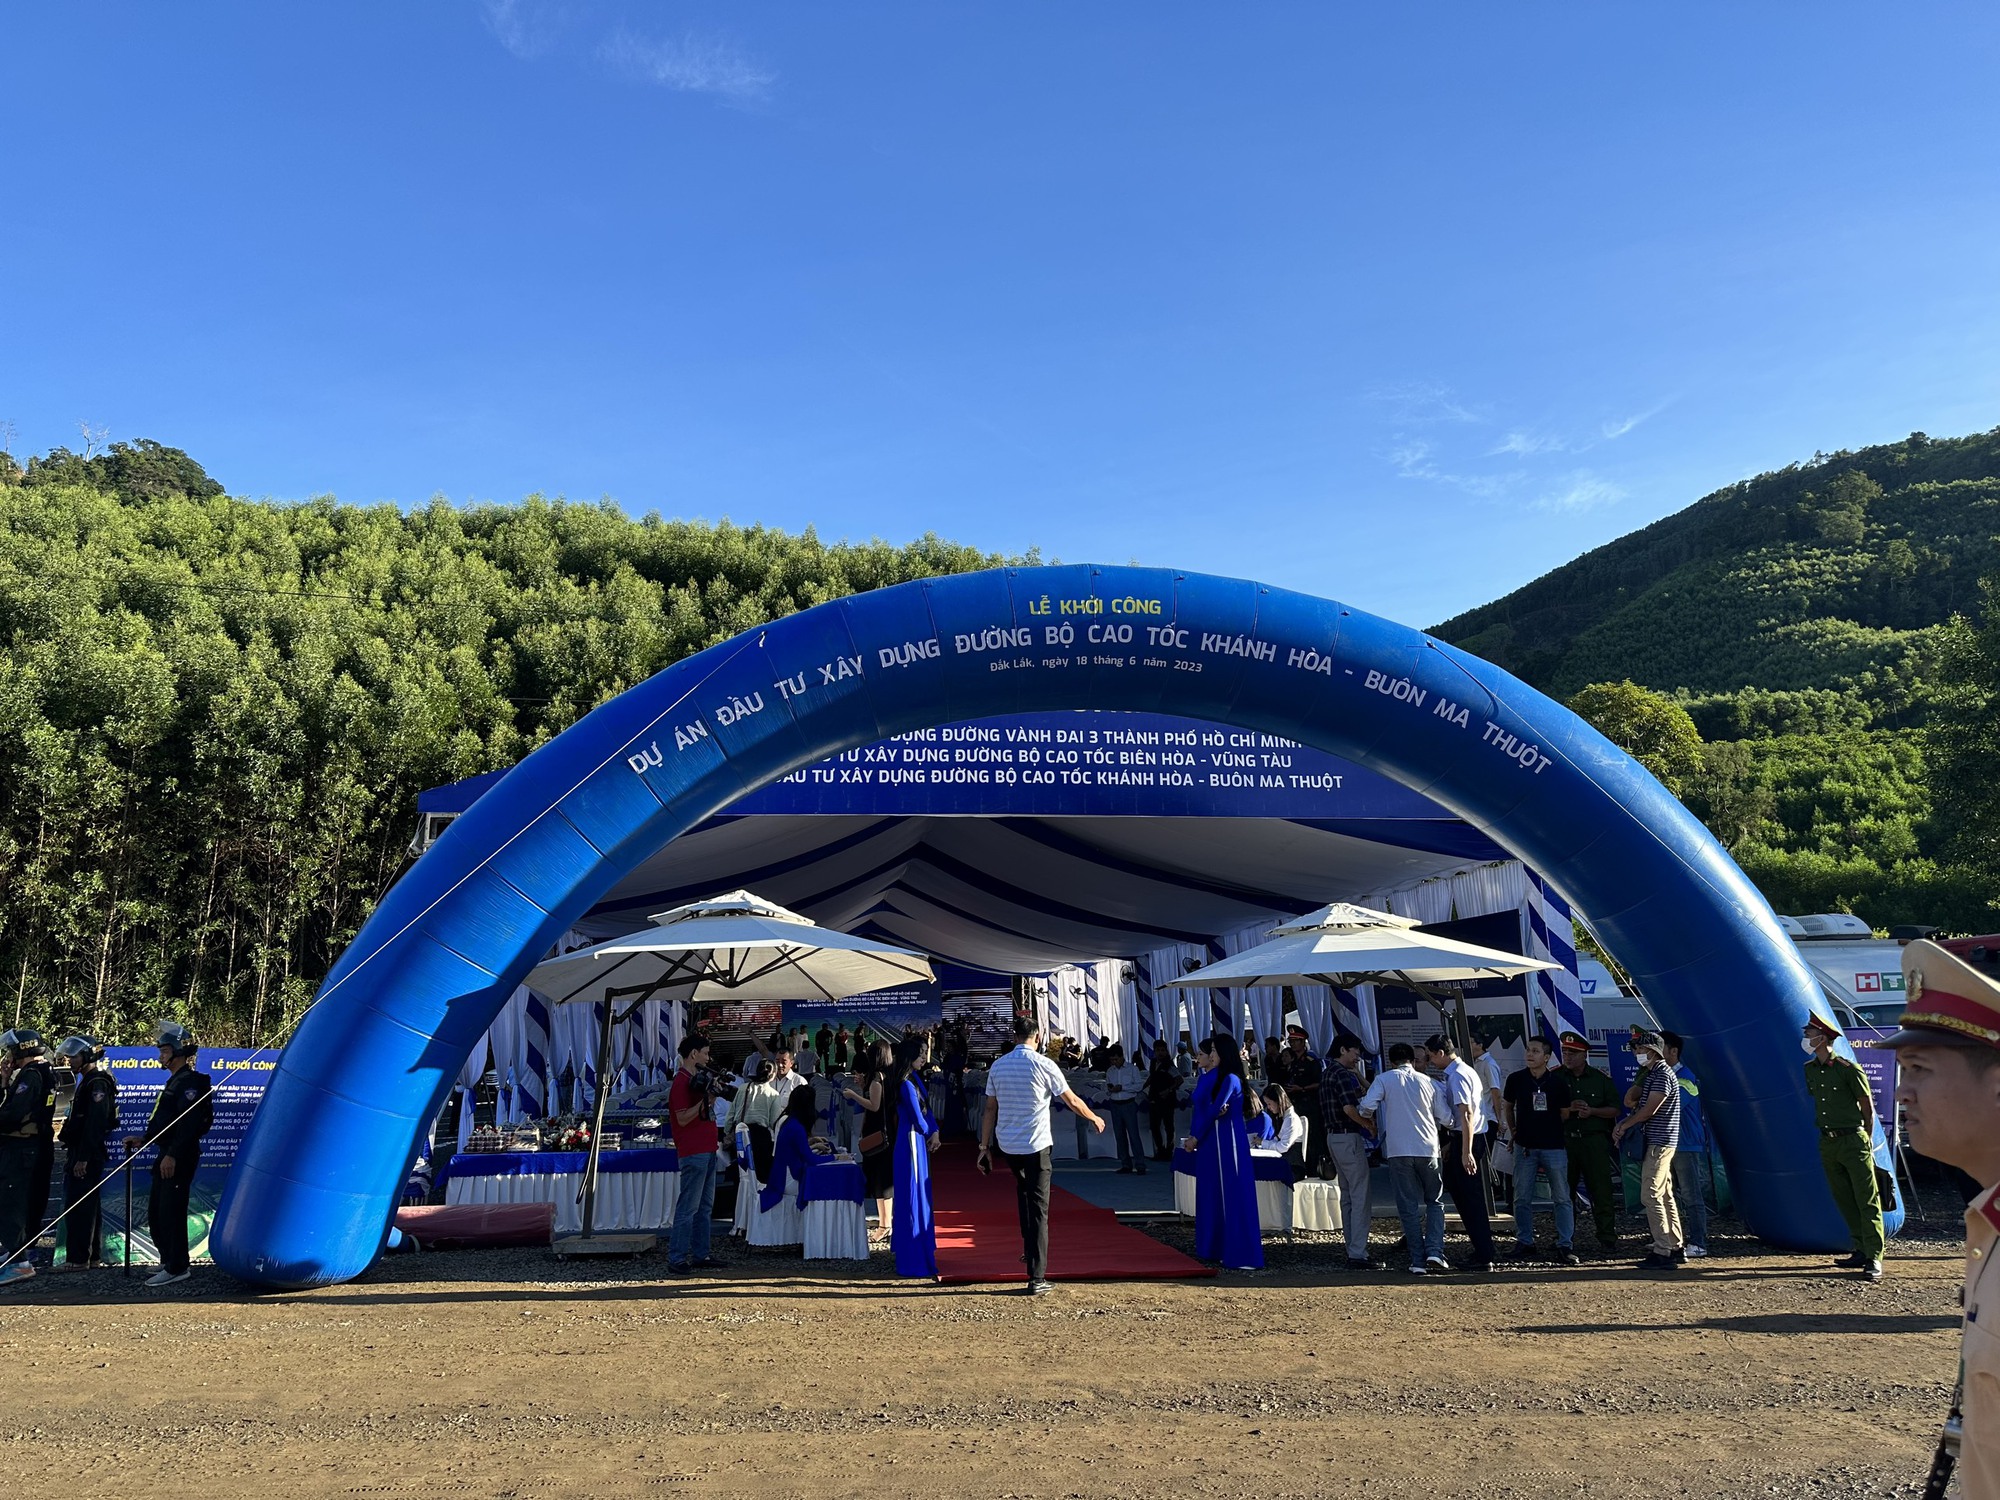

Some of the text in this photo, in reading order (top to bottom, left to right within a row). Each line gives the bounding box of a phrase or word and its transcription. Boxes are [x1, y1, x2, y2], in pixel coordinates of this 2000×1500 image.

[1029, 595, 1161, 615] LỄ KHỞI CÔNG
[990, 658, 1010, 672] Đắk
[1042, 656, 1069, 668] ngày
[1076, 656, 1088, 665] 18
[1093, 655, 1123, 668] tháng
[1129, 656, 1136, 665] 6
[1143, 656, 1167, 668] năm
[1173, 660, 1203, 673] 2023
[628, 741, 663, 774] DỰ
[674, 720, 708, 751] ÁN
[715, 691, 764, 726] ĐẦU
[774, 671, 807, 700] TƯ
[817, 655, 863, 685] XÂY
[878, 639, 941, 668] DỰNG
[955, 625, 1032, 654] ĐƯỜNG
[1045, 621, 1074, 648] BỘ
[1088, 624, 1133, 644] CAO
[1147, 622, 1189, 649] TỐC
[1200, 633, 1277, 662] KHÁNH
[1287, 647, 1332, 675] HÒA
[1363, 669, 1427, 707] BUÔN
[1433, 698, 1470, 729] MA
[1482, 721, 1552, 774] THUỘT
[942, 726, 1000, 742] ĐƯỜNG
[1005, 726, 1051, 743] VÀNH
[1056, 730, 1084, 744] ĐAI
[1089, 730, 1098, 744] 3
[1103, 729, 1159, 745] THÀNH
[1164, 729, 1197, 746] PHỐ
[1202, 729, 1225, 747] HỒ
[1230, 731, 1255, 748] CHÍ
[864, 746, 897, 762] XÂY
[903, 748, 949, 765] DỰNG
[955, 746, 1012, 763] ĐƯỜNG
[1018, 747, 1040, 766] BỘ
[1045, 750, 1078, 764] CAO
[1083, 747, 1115, 764] TỐC
[1120, 749, 1156, 765] BIÊN
[1161, 750, 1196, 766] HÒA
[1211, 751, 1256, 767] VŨNG
[1261, 752, 1292, 767] TÀU
[812, 768, 835, 783] TƯ
[840, 767, 873, 783] XÂY
[879, 768, 925, 786] DỰNG
[931, 767, 989, 783] ĐƯỜNG
[995, 768, 1017, 787] BỘ
[1022, 770, 1055, 784] CAO
[1060, 767, 1092, 785] TỐC
[1097, 769, 1154, 786] KHÁNH
[1159, 770, 1194, 786] HÒA
[1210, 772, 1254, 787] BUÔN
[1259, 775, 1285, 788] MA
[1289, 773, 1343, 792] THUỘT
[1849, 1039, 1862, 1048] HỞI
[140, 1058, 162, 1069] CÔN
[211, 1058, 224, 1069] LỄ
